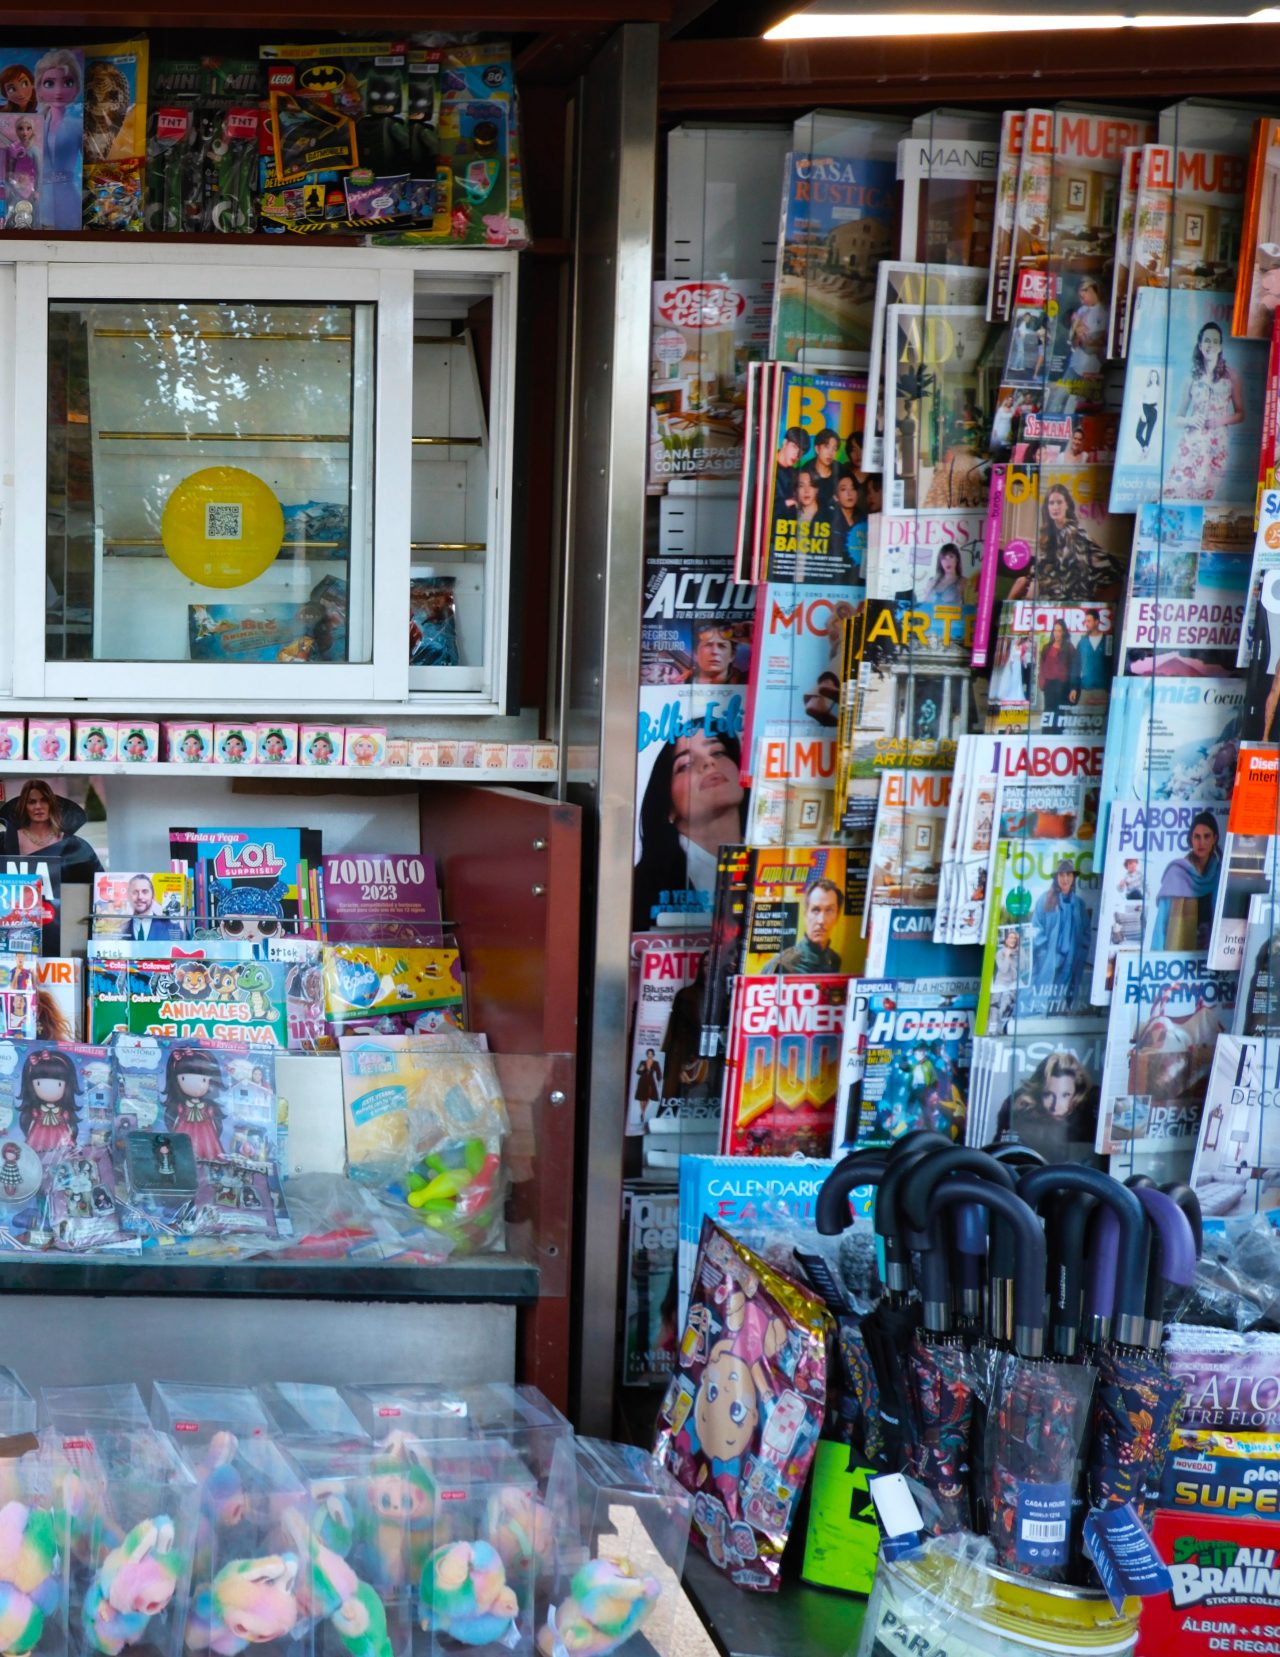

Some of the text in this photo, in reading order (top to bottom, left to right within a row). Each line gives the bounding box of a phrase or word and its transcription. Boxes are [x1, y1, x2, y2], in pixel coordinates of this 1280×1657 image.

[270, 74, 293, 84] LEGO
[161, 117, 183, 126] TNT
[231, 117, 253, 126] TNT
[1030, 114, 1055, 154] EL
[797, 161, 856, 184] CASA
[1147, 149, 1175, 190] EL
[657, 288, 740, 308] cosas
[672, 307, 737, 327] casa
[1024, 414, 1072, 438] SEMANA
[655, 449, 691, 460] GANA
[655, 460, 725, 472] CON IDEAS
[776, 519, 830, 536] BTS IS
[888, 519, 969, 545] DRESS
[775, 536, 829, 554] BACK!
[1012, 601, 1113, 632] LECTURS
[1139, 603, 1244, 624] ESCAPADAS
[642, 630, 679, 640] REGRESO
[1136, 623, 1241, 646] POR ESPAÑA
[642, 641, 685, 651] AL FUTURO
[638, 700, 702, 752] Billie
[1040, 712, 1103, 727] El nuevo
[765, 742, 792, 779] EL
[873, 754, 955, 768] ARTISTAS
[1004, 747, 1105, 778] LABORE
[885, 776, 907, 806] EL
[1005, 787, 1075, 798] PATCHWORK DE
[1004, 798, 1075, 809] TEMPORADA
[184, 832, 239, 843] Pinta Pega
[1119, 831, 1192, 852] PUNTO
[225, 868, 273, 876] SURPRISE!
[328, 860, 425, 885] ZODIACO
[361, 885, 398, 900] 2023
[643, 984, 674, 995] Blusas
[746, 983, 819, 1006] retro
[857, 981, 970, 993] ESPECIAL HISTORIA
[642, 990, 675, 1003] fáciles
[160, 1002, 250, 1021] ANIMALES
[743, 1005, 846, 1033] GAMER
[148, 1024, 176, 1038] DE
[181, 1024, 209, 1041] LA
[213, 1025, 278, 1044] SELVA
[1150, 1106, 1198, 1122] IDEAS
[1176, 1461, 1213, 1472] NOVEDAD
[1175, 1482, 1280, 1512] SUPE
[1206, 1596, 1248, 1606] STICKER
[1182, 1617, 1261, 1636] ÁLBUM 4
[1210, 1637, 1230, 1650] DE
